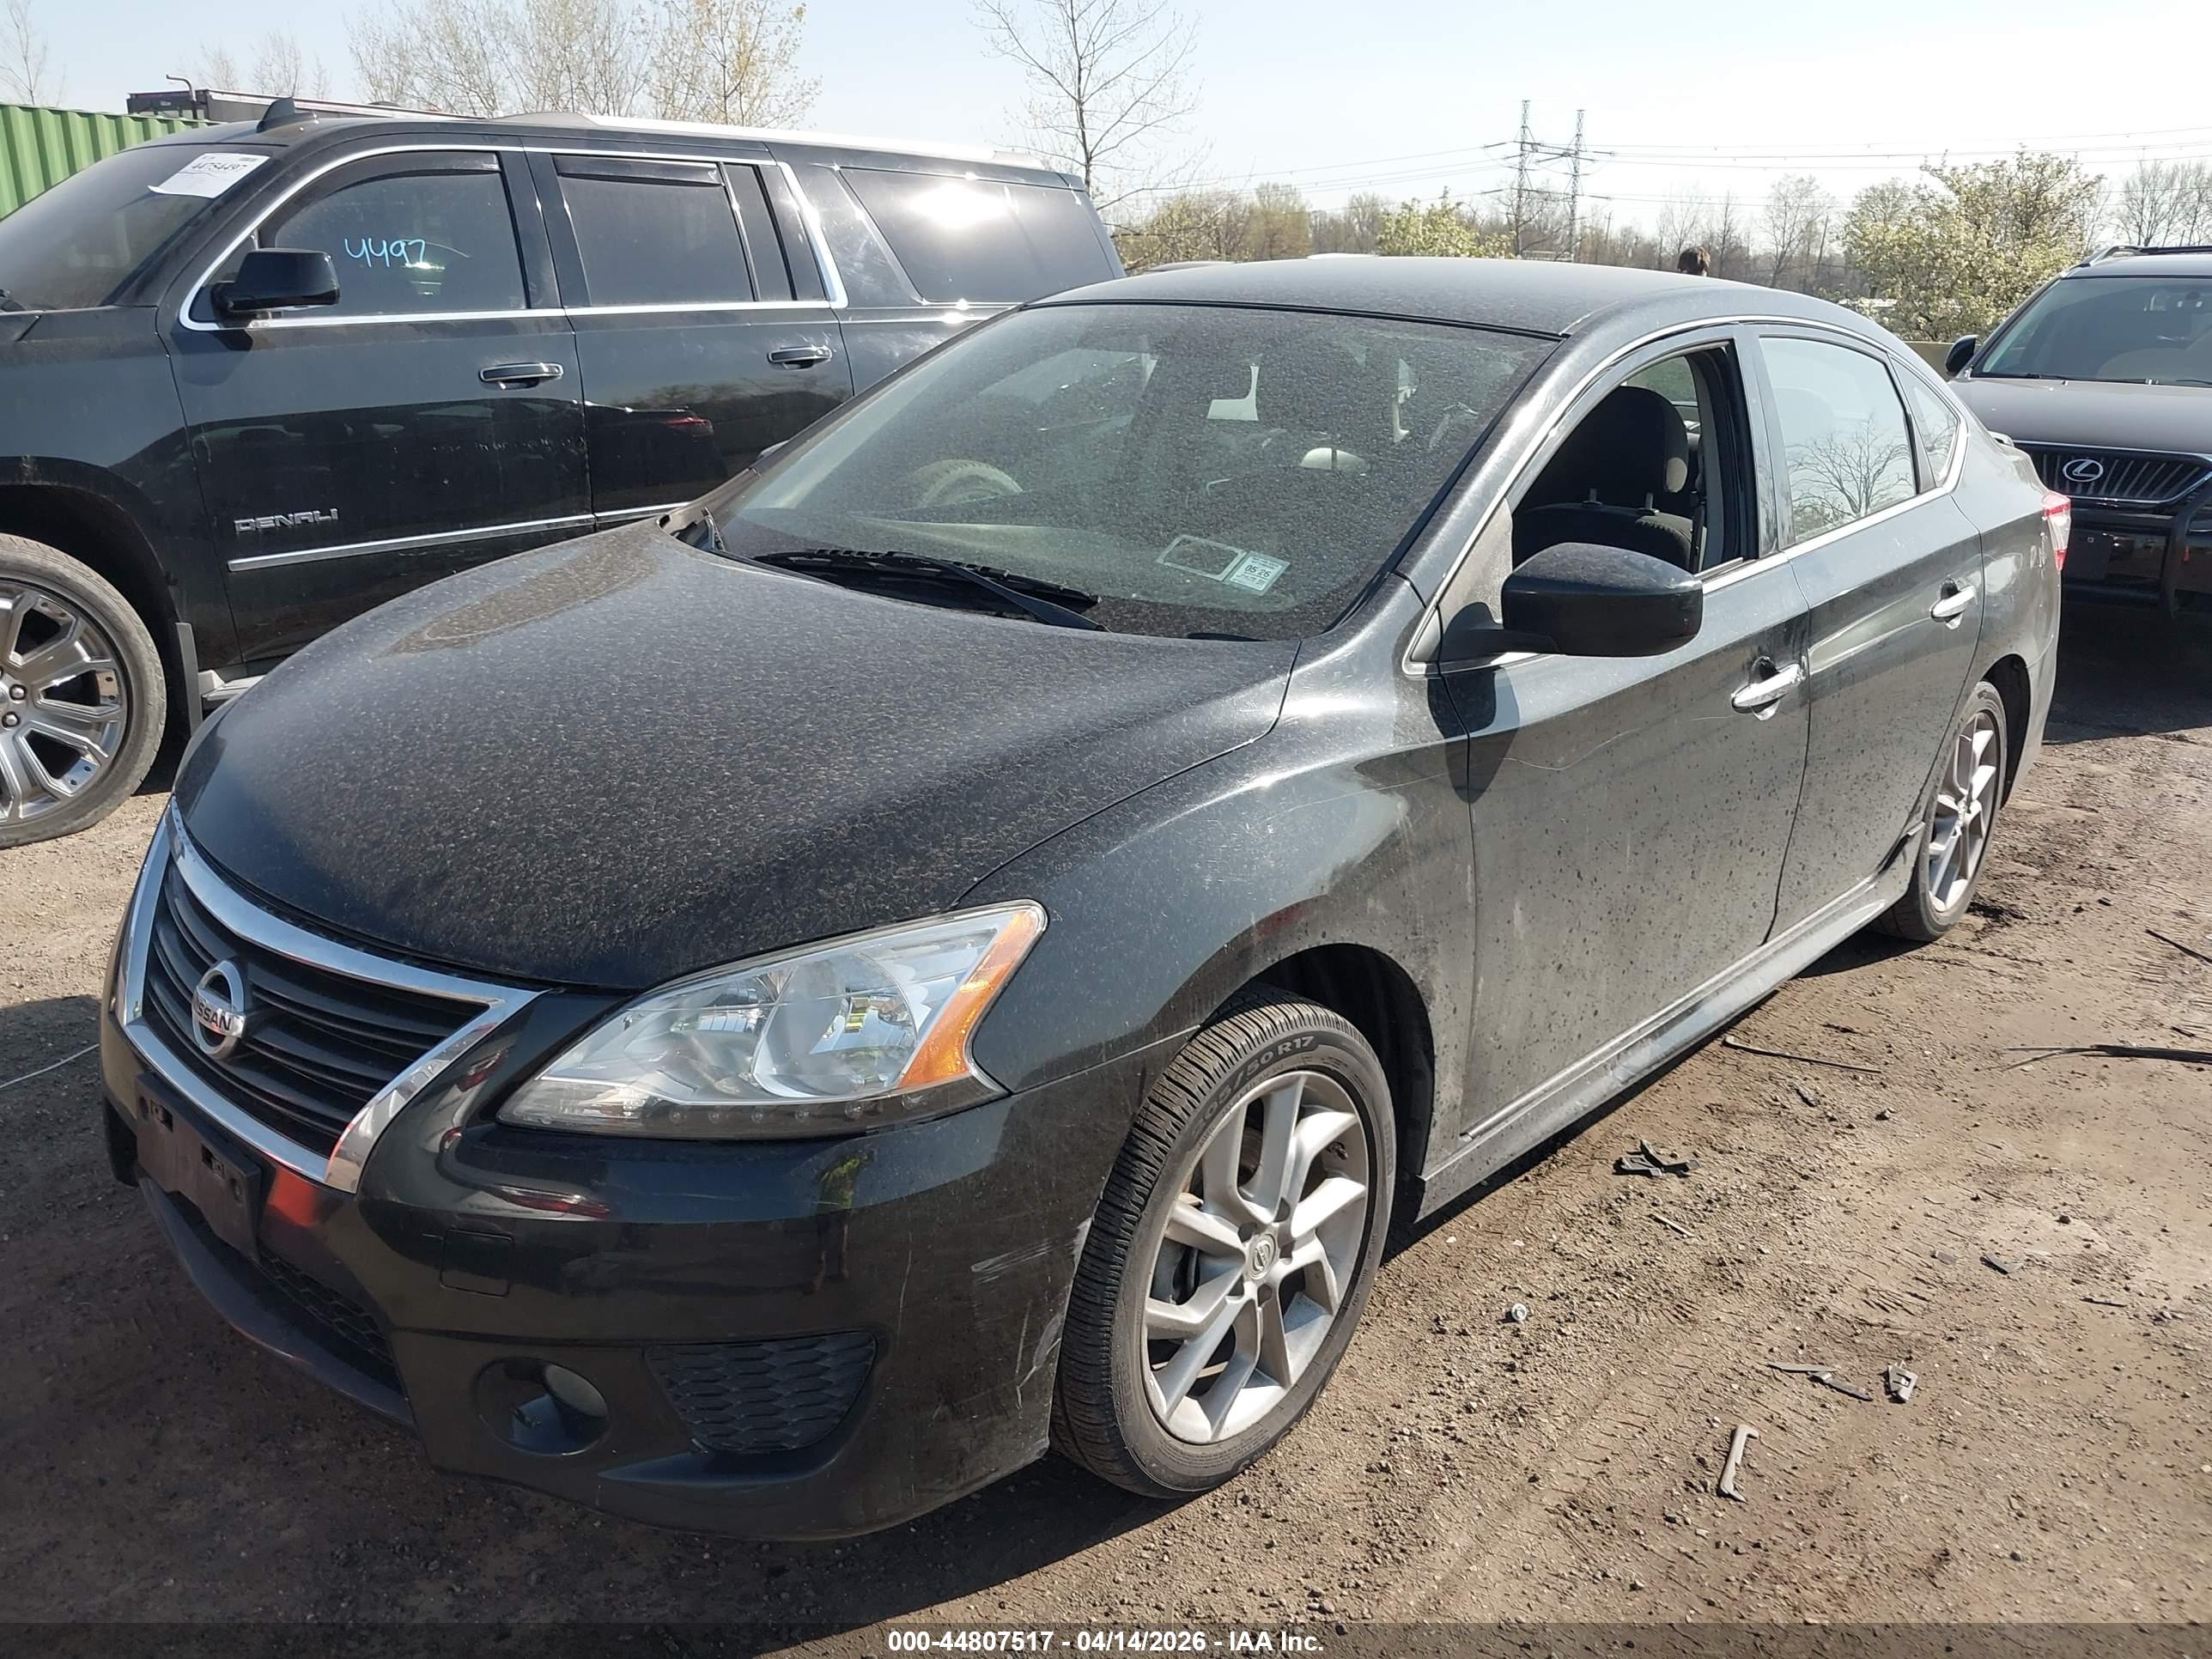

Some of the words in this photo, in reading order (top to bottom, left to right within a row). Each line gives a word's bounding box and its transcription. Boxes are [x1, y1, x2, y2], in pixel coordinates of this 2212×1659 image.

[343, 237, 427, 268] 4497
[233, 507, 338, 532] DENALI
[1277, 1035, 1316, 1056] R17
